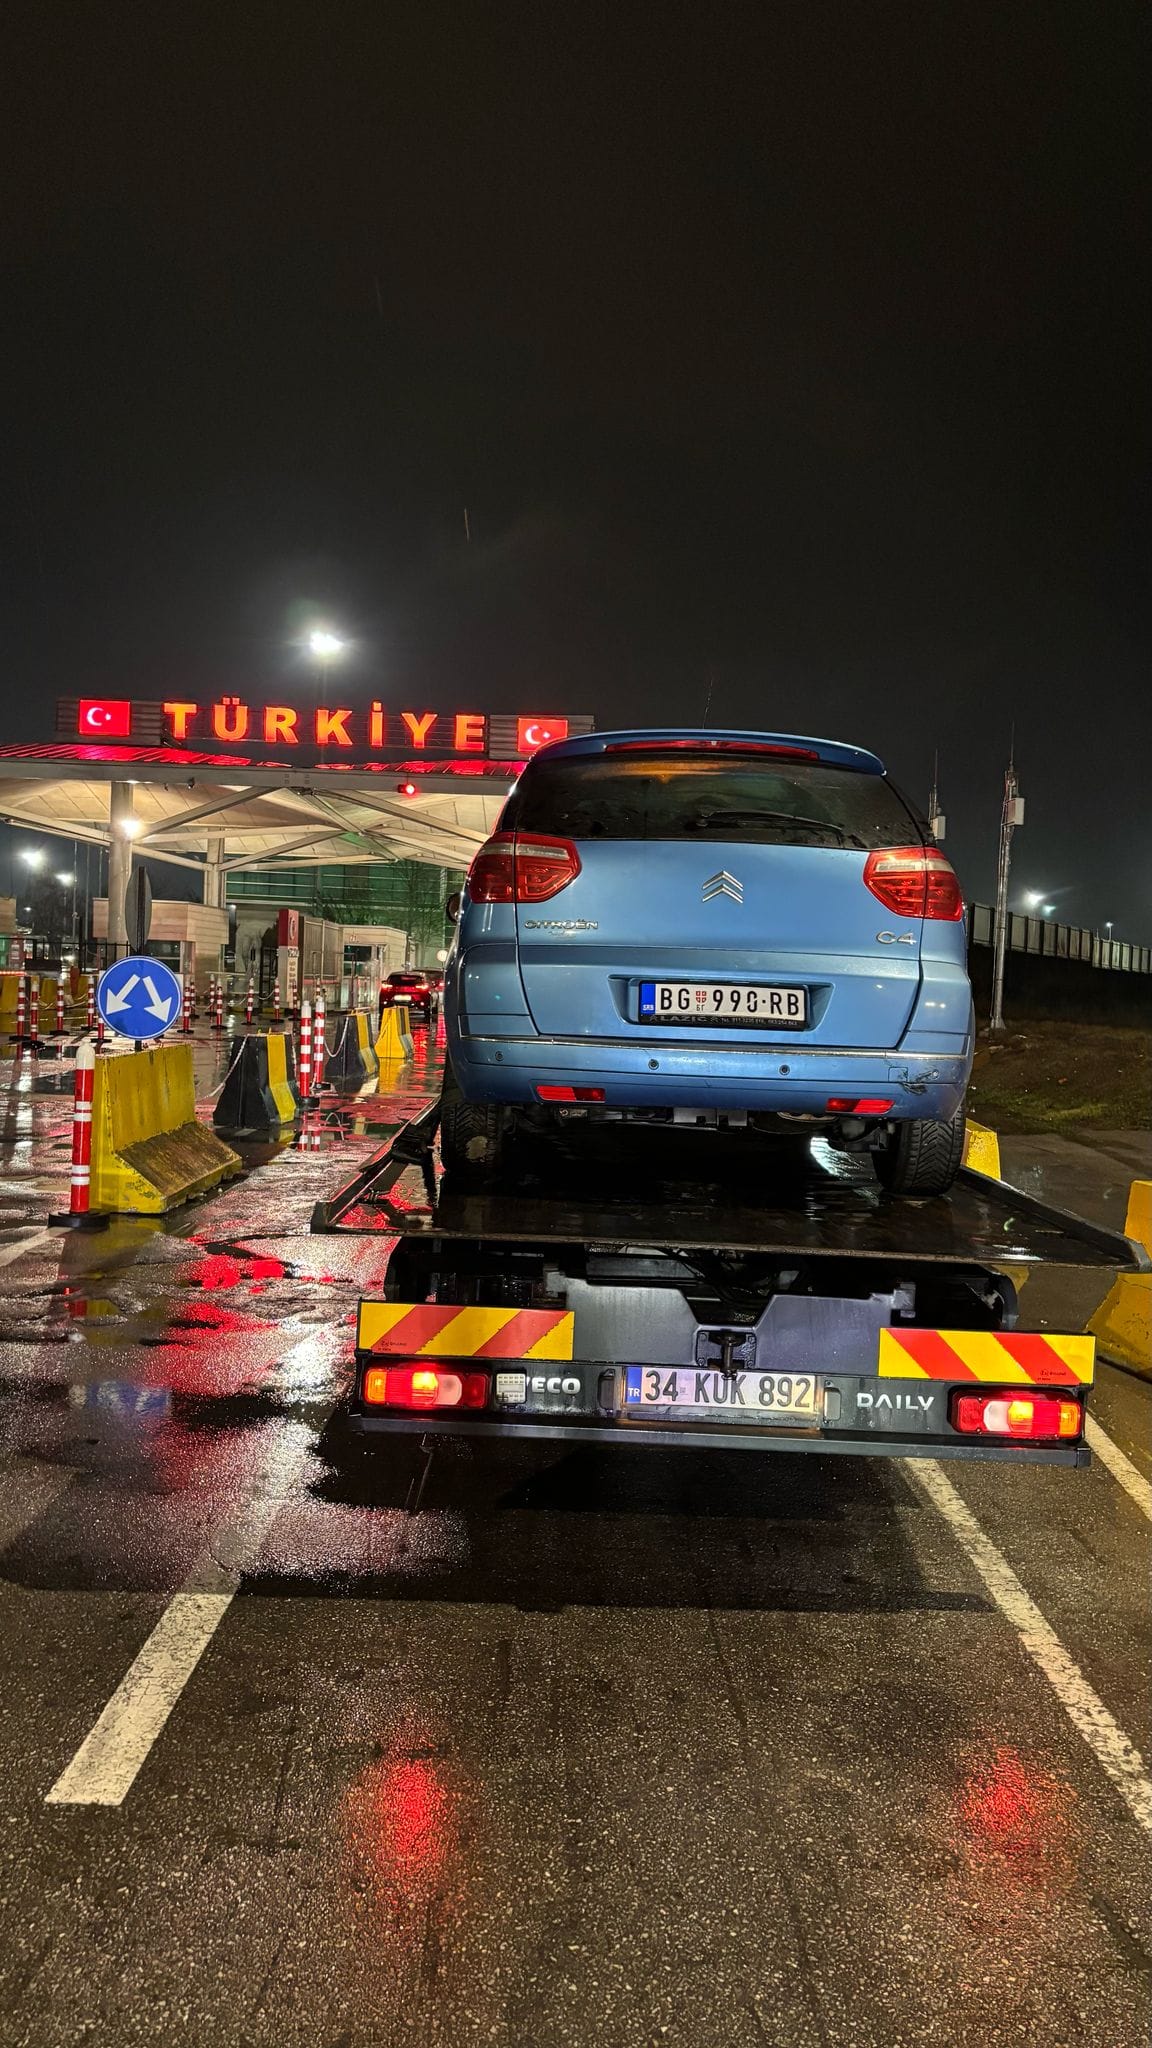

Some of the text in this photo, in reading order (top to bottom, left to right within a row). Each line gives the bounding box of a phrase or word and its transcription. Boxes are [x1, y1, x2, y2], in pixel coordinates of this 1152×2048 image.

[163, 697, 486, 752] TÜRKİYE
[524, 918, 599, 930] CITROËN
[875, 930, 917, 945] C4
[660, 987, 690, 1011] BG
[627, 1387, 641, 1398] TR
[644, 1369, 811, 1408] 34 KUK 892
[856, 1392, 935, 1411] DAILY
